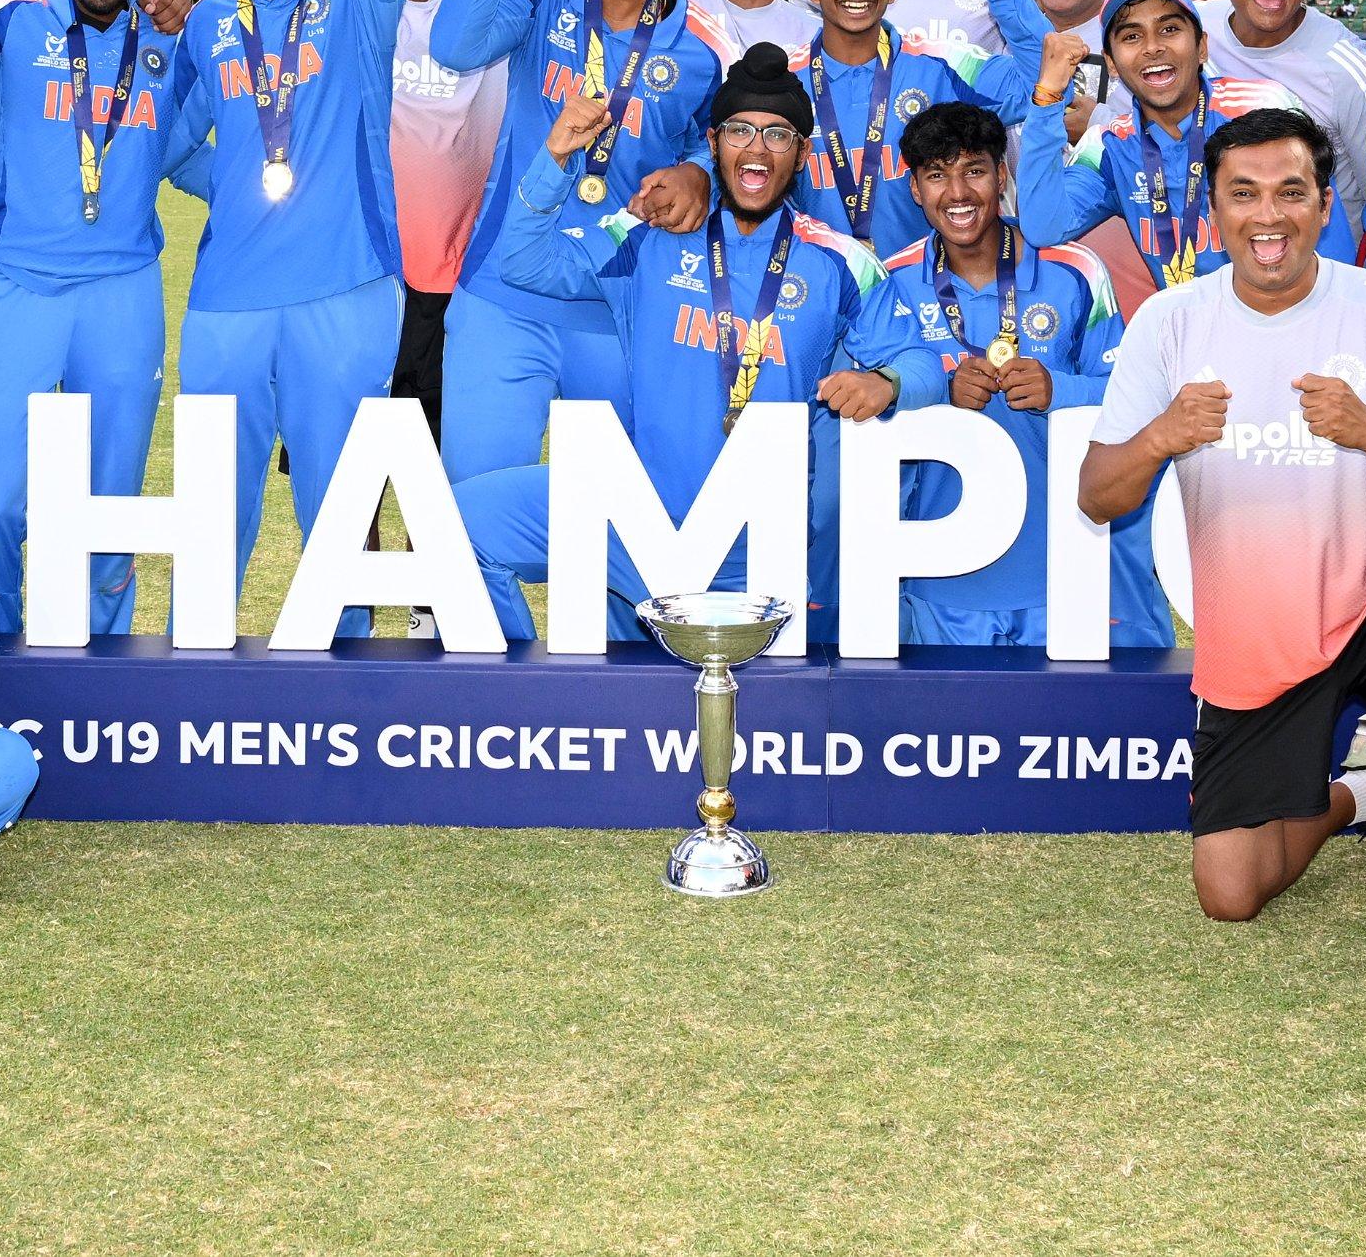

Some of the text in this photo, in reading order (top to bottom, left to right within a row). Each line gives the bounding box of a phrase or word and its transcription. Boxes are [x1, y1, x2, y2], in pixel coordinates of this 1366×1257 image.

[288, 5, 300, 43] WINNER
[307, 27, 325, 37] U-19
[218, 41, 324, 101] INDA
[620, 51, 640, 87] WINNER
[393, 78, 456, 99] TYRES
[644, 91, 660, 103] U-19
[827, 130, 845, 168] WINNER
[860, 175, 873, 213] WINNER
[712, 240, 723, 279] WINNER
[673, 304, 786, 366] INDA
[778, 313, 796, 322] U-19
[1031, 345, 1048, 354] U-19
[1253, 448, 1337, 466] TYRES
[62, 719, 160, 764] U19
[179, 721, 360, 767] MEN'S
[377, 723, 627, 772] CRICKET
[881, 733, 1001, 780] CUP
[1018, 735, 1193, 781] ZIMBA
